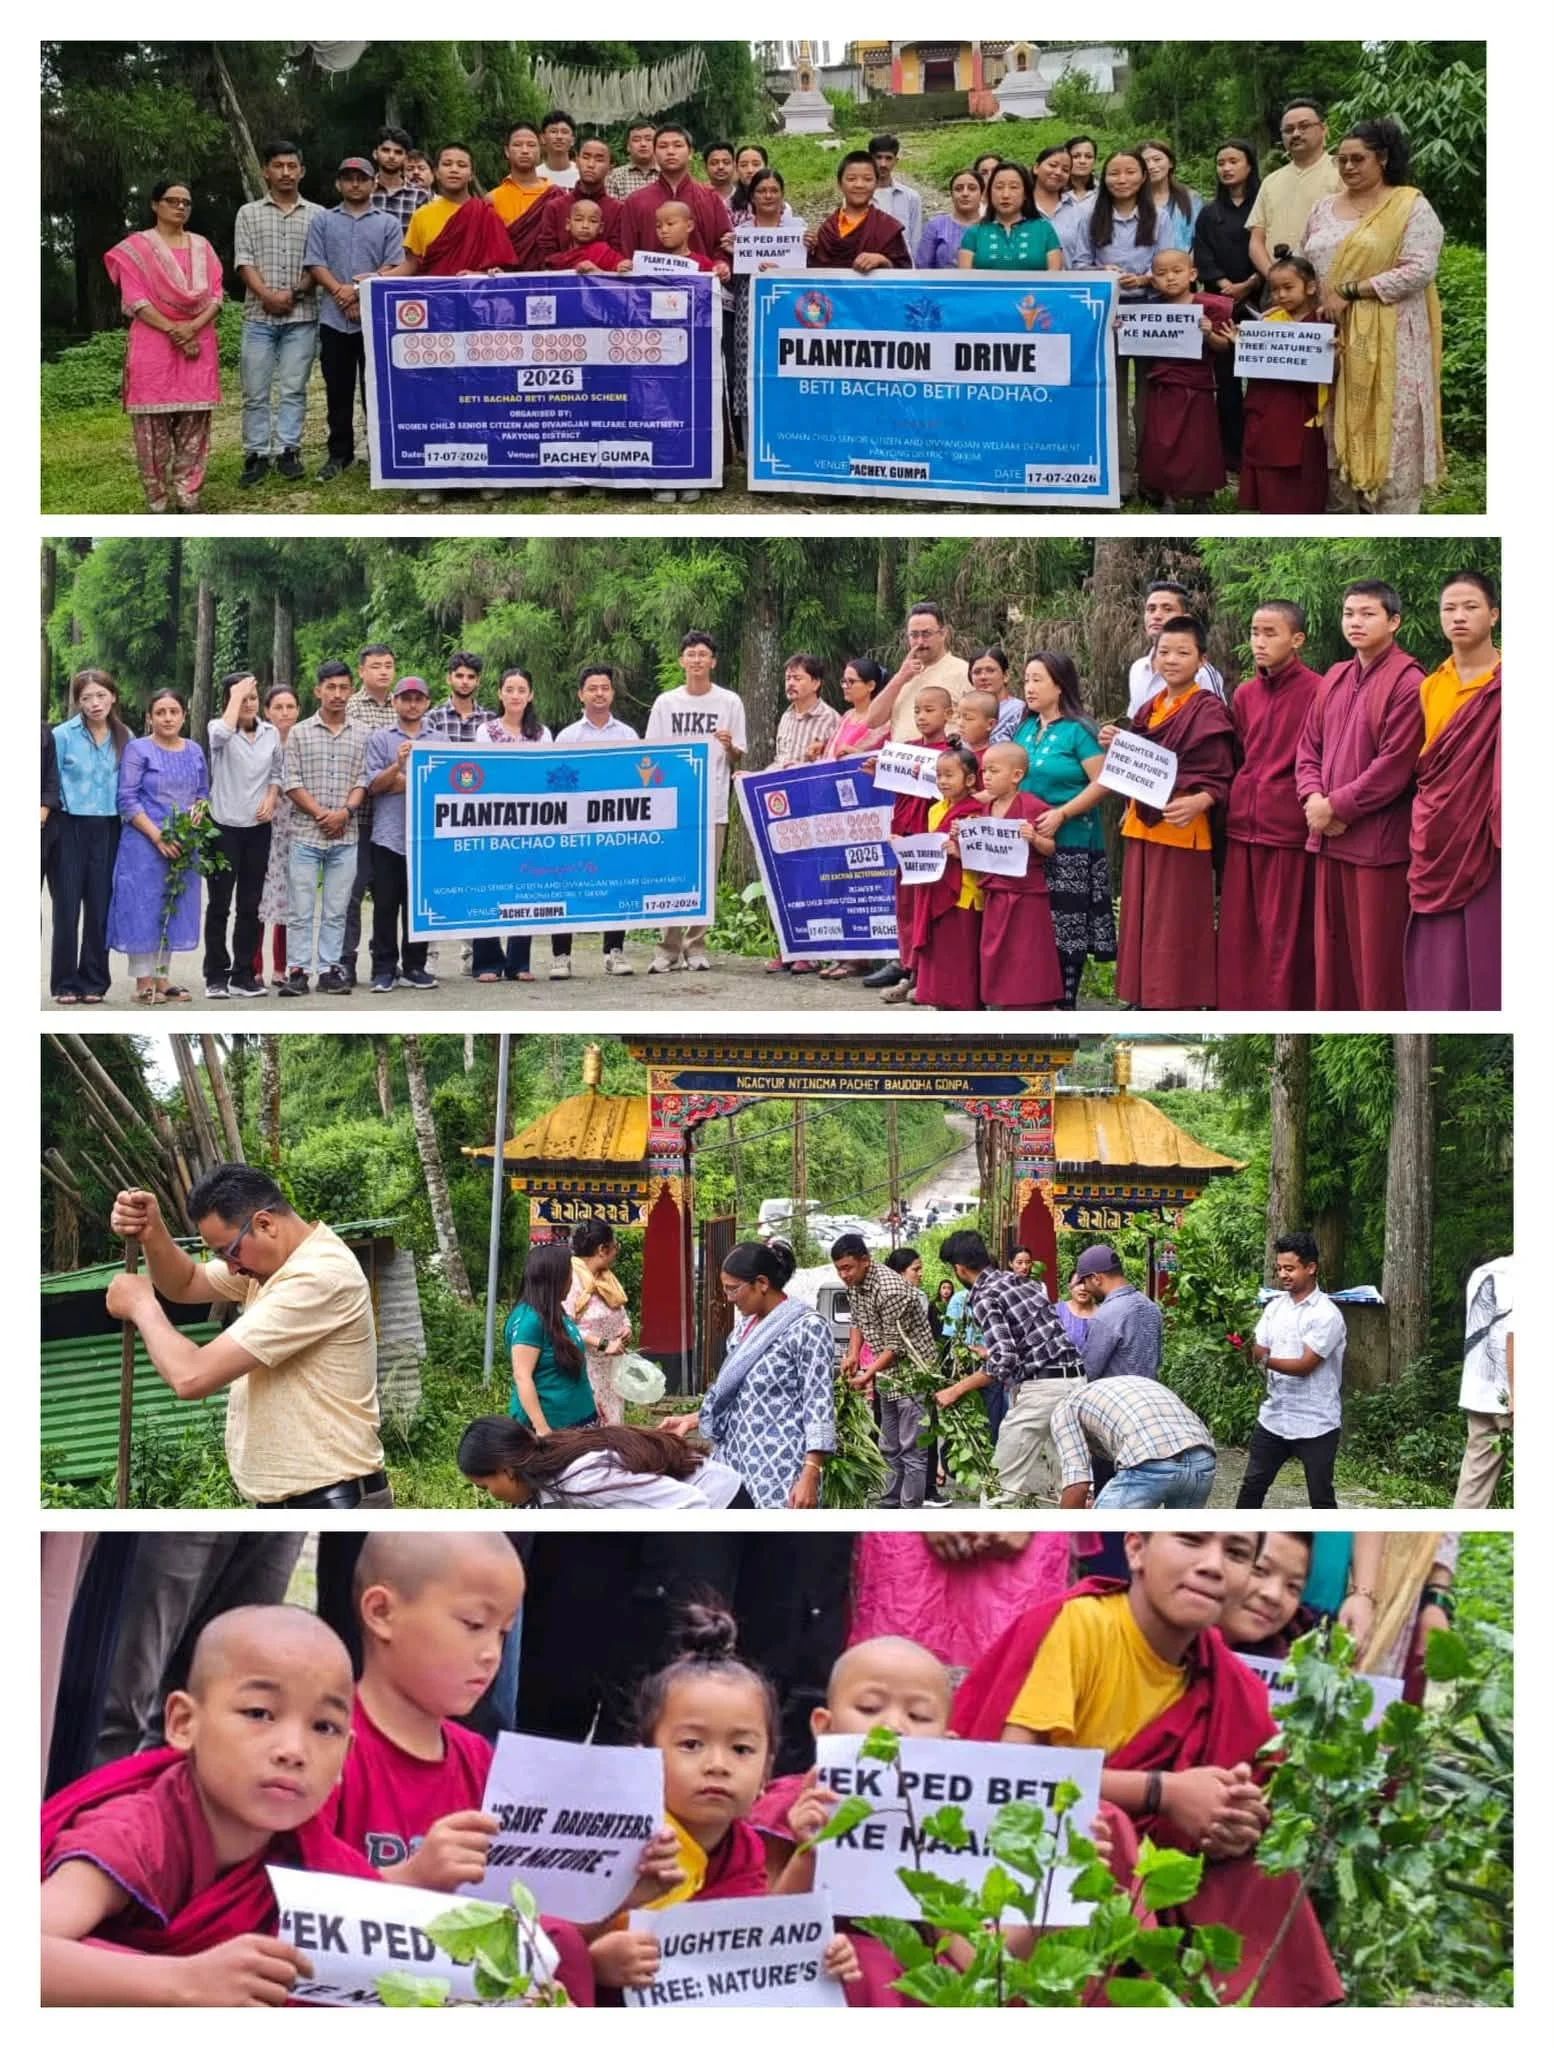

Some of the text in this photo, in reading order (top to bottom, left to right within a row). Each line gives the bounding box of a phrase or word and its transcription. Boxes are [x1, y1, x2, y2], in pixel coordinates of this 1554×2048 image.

[753, 235, 774, 244] PED
[776, 235, 801, 244] BETI
[739, 249, 753, 258] KE
[1140, 313, 1162, 323] PED
[1166, 313, 1195, 323] BETI
[1123, 329, 1185, 339] KE NAAM"
[1239, 330, 1321, 341] DAUGHTER AND
[778, 337, 1037, 373] PLANTATION DRIVE
[1238, 355, 1308, 366] BEST DECREE
[522, 368, 575, 387] 2026
[799, 379, 1053, 403] BETI BACHAO BETI PADHAO.
[459, 394, 628, 404] BETI BACHAO BETI PADHAO SCHEME
[398, 423, 428, 431] WOMEN
[430, 422, 456, 430] CHILD
[457, 422, 488, 430] SENIOR
[522, 421, 540, 430] AND
[542, 431, 582, 440] DISTRICT
[427, 452, 489, 462] 17-07-2026
[542, 451, 597, 463] PACHEY
[600, 450, 650, 463] GUMPA
[889, 465, 927, 480] GUMPA
[1027, 472, 1098, 484] 17-07-2026
[671, 712, 719, 734] NIKE
[1114, 737, 1154, 760] DAUGHTER
[880, 762, 892, 772] KE
[1105, 763, 1127, 777] BEST
[435, 796, 652, 829] PLANTATION DRIVE
[996, 828, 1021, 840] BETI
[453, 831, 665, 853] BETI BACHAO BETI PADHAO.
[966, 841, 983, 851] KE
[848, 846, 879, 864] 2026
[533, 906, 565, 917] GUMPA
[644, 899, 698, 911] 17-07-2026
[736, 1076, 785, 1089] NGAGYUR
[840, 1078, 880, 1090] PACHEY
[896, 1770, 974, 1802] PED
[986, 1776, 1062, 1808] BET
[492, 1803, 548, 1834] "SAVE
[486, 1843, 532, 1867] AVE
[360, 1918, 437, 1962] PED
[662, 1920, 822, 1958] UGHTER AND
[706, 1960, 819, 1998] NATURE'S
